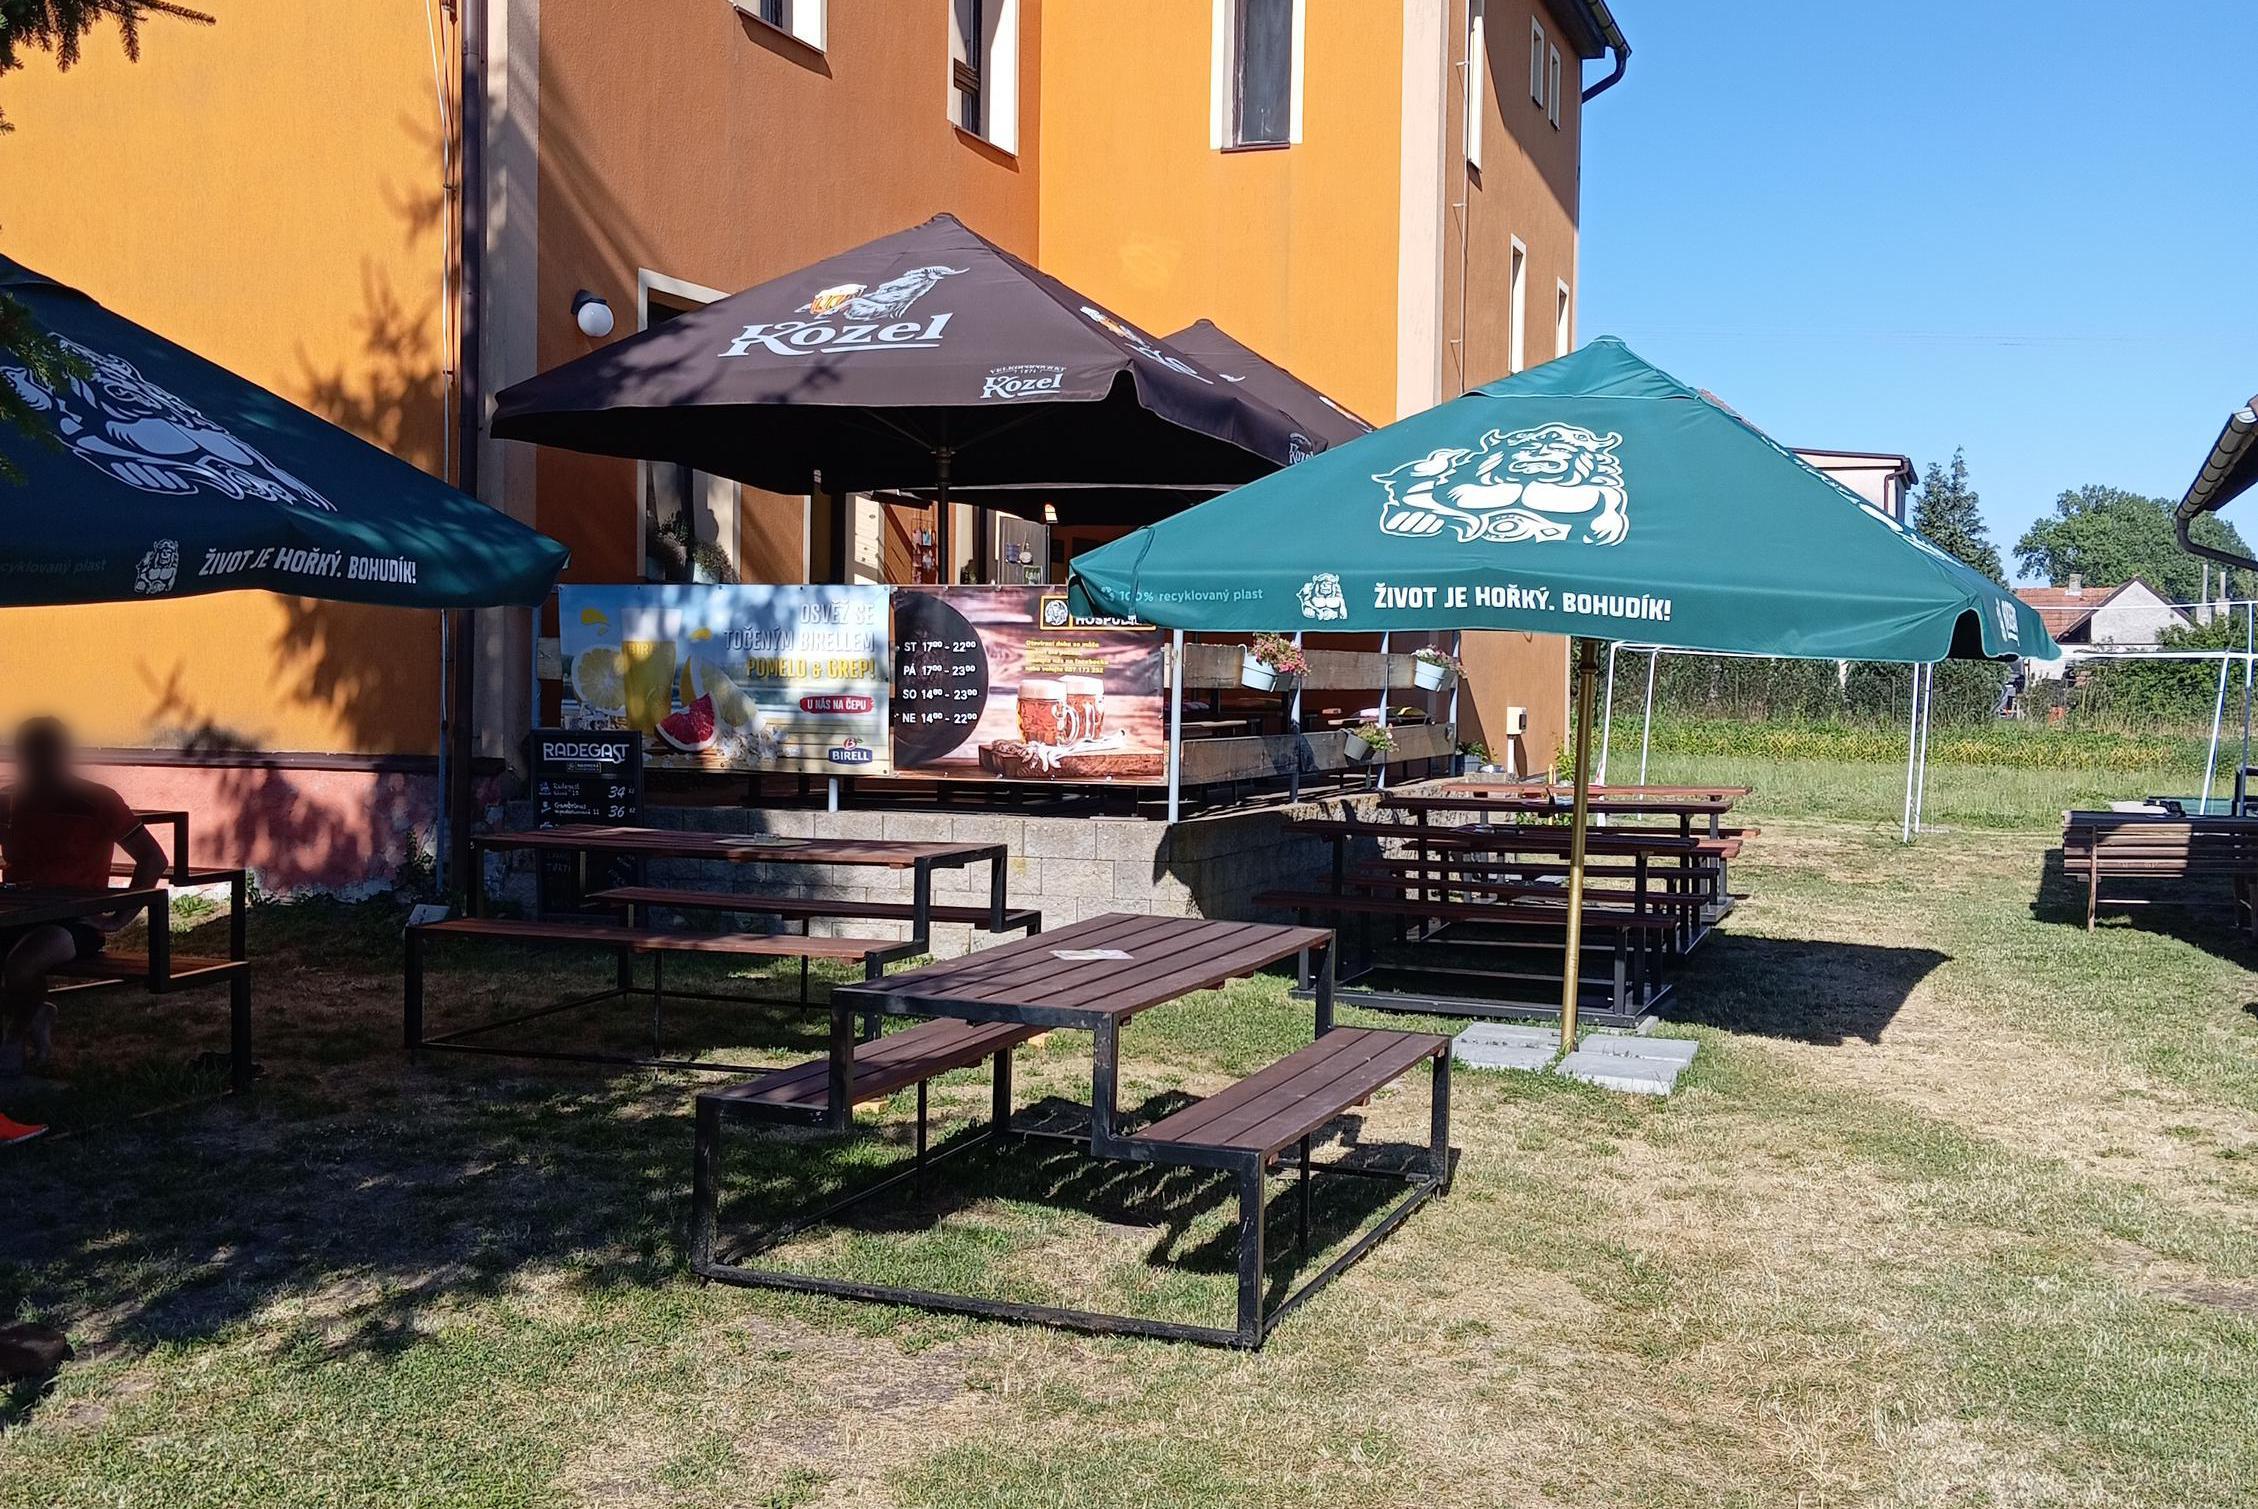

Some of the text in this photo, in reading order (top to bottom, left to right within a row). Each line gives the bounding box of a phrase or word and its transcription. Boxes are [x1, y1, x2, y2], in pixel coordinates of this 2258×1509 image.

[717, 313, 953, 357] Kozel
[980, 373, 1063, 399] Kozel
[198, 547, 417, 584] ŽIVOT JE HOŘKÝ. BOHUDÍK!
[1159, 589, 1229, 602] recyklovaný
[1233, 588, 1263, 602] plast
[1374, 582, 1672, 622] ŽIVOT JE HOŘKÝ. BOHUDÍK!
[801, 600, 875, 625] OSVĚŽ SE
[724, 626, 875, 652] TOČENÝM BIRELLEM
[904, 641, 917, 652] ST
[746, 656, 876, 679] POMELO & GREP!
[903, 663, 916, 676] PÁ
[902, 689, 917, 699] SO
[807, 697, 867, 710] U NÁS NA ČEPU
[902, 712, 916, 723] NE
[543, 742, 630, 765] RADEGAST
[832, 751, 870, 761] BIRELL
[608, 785, 626, 799] 34
[608, 805, 626, 818] 36
